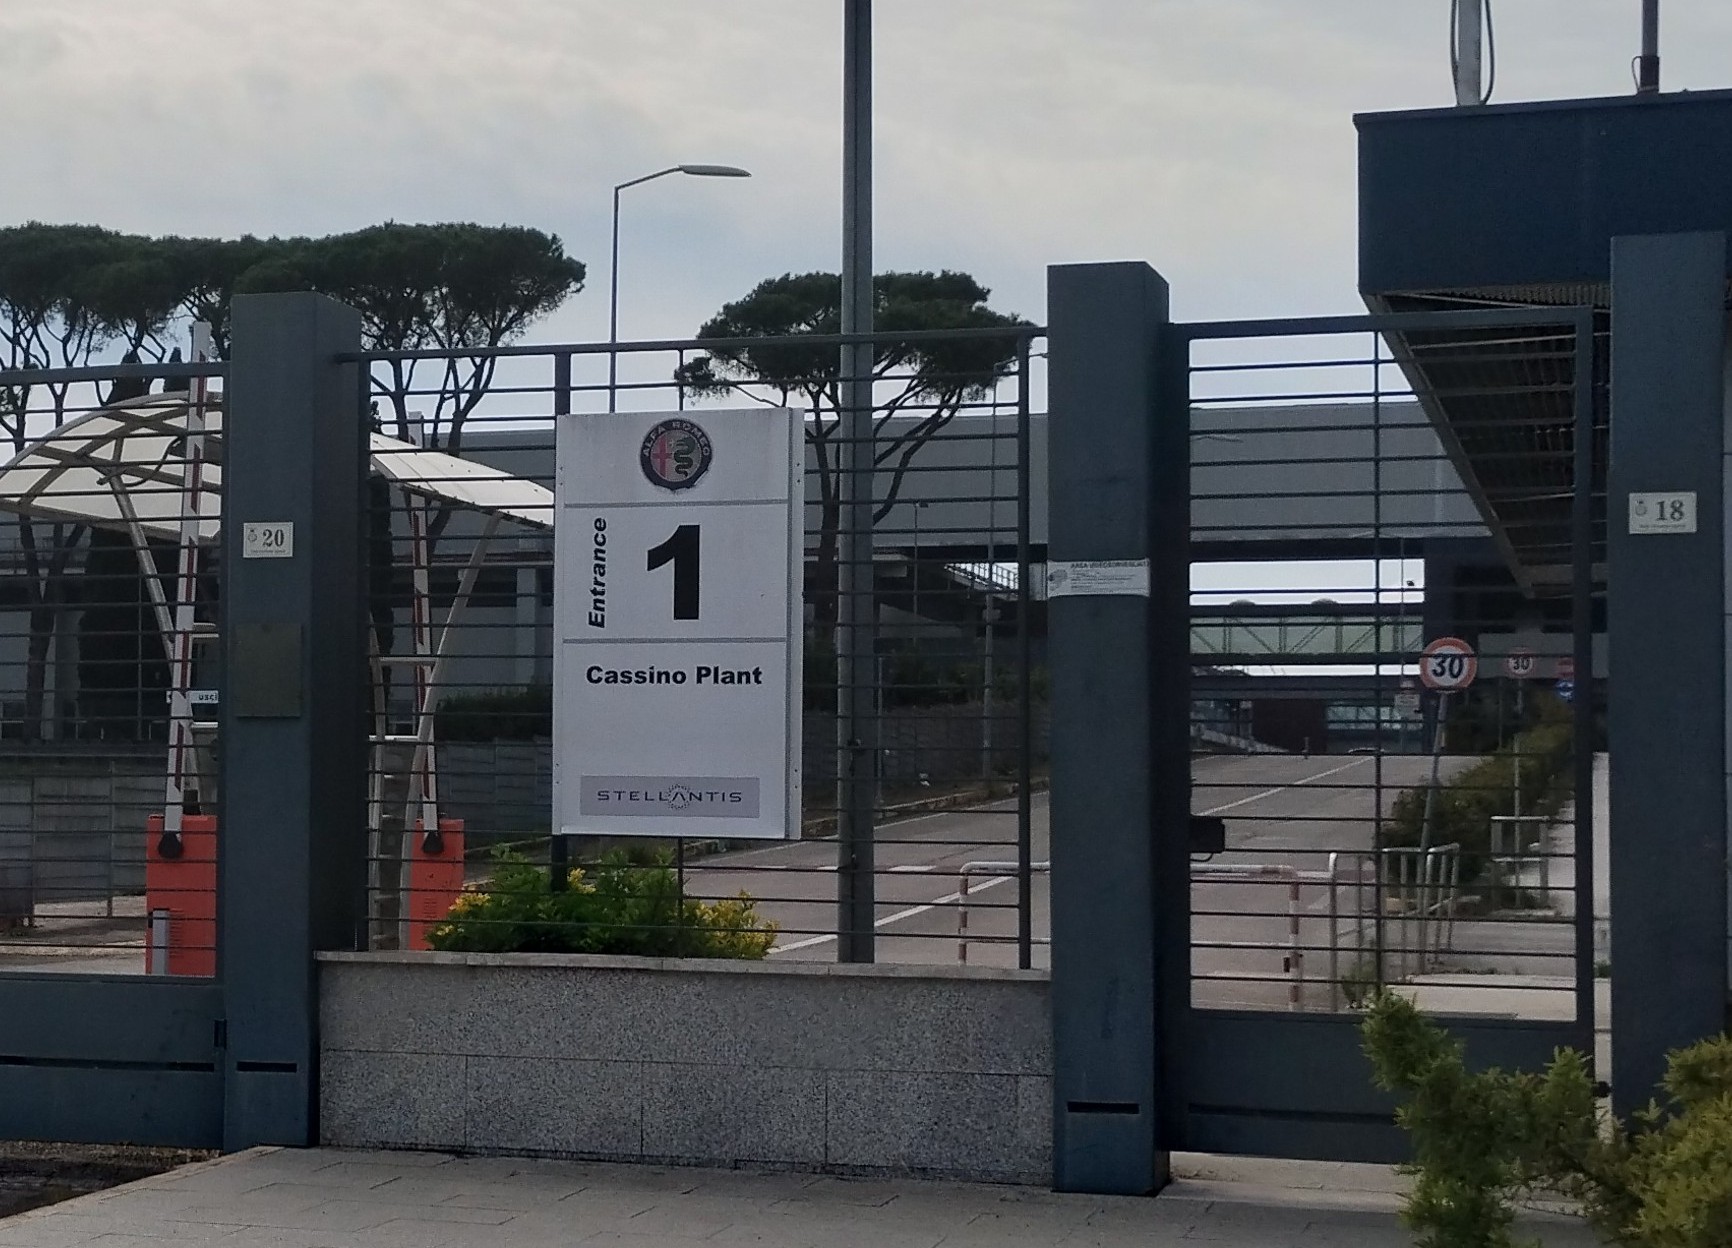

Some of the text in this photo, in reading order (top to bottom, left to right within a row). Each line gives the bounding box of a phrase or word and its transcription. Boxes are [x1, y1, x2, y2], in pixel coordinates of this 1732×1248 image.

[643, 421, 710, 457] ALFA ROMEO
[1656, 500, 1684, 521] 18
[262, 529, 284, 547] 20
[588, 517, 607, 628] Entrance
[647, 524, 700, 620] 1
[1431, 653, 1463, 679] 30
[1512, 656, 1530, 671] 30
[586, 666, 763, 685] Cassino Plant
[597, 790, 742, 803] STELLANTIS
